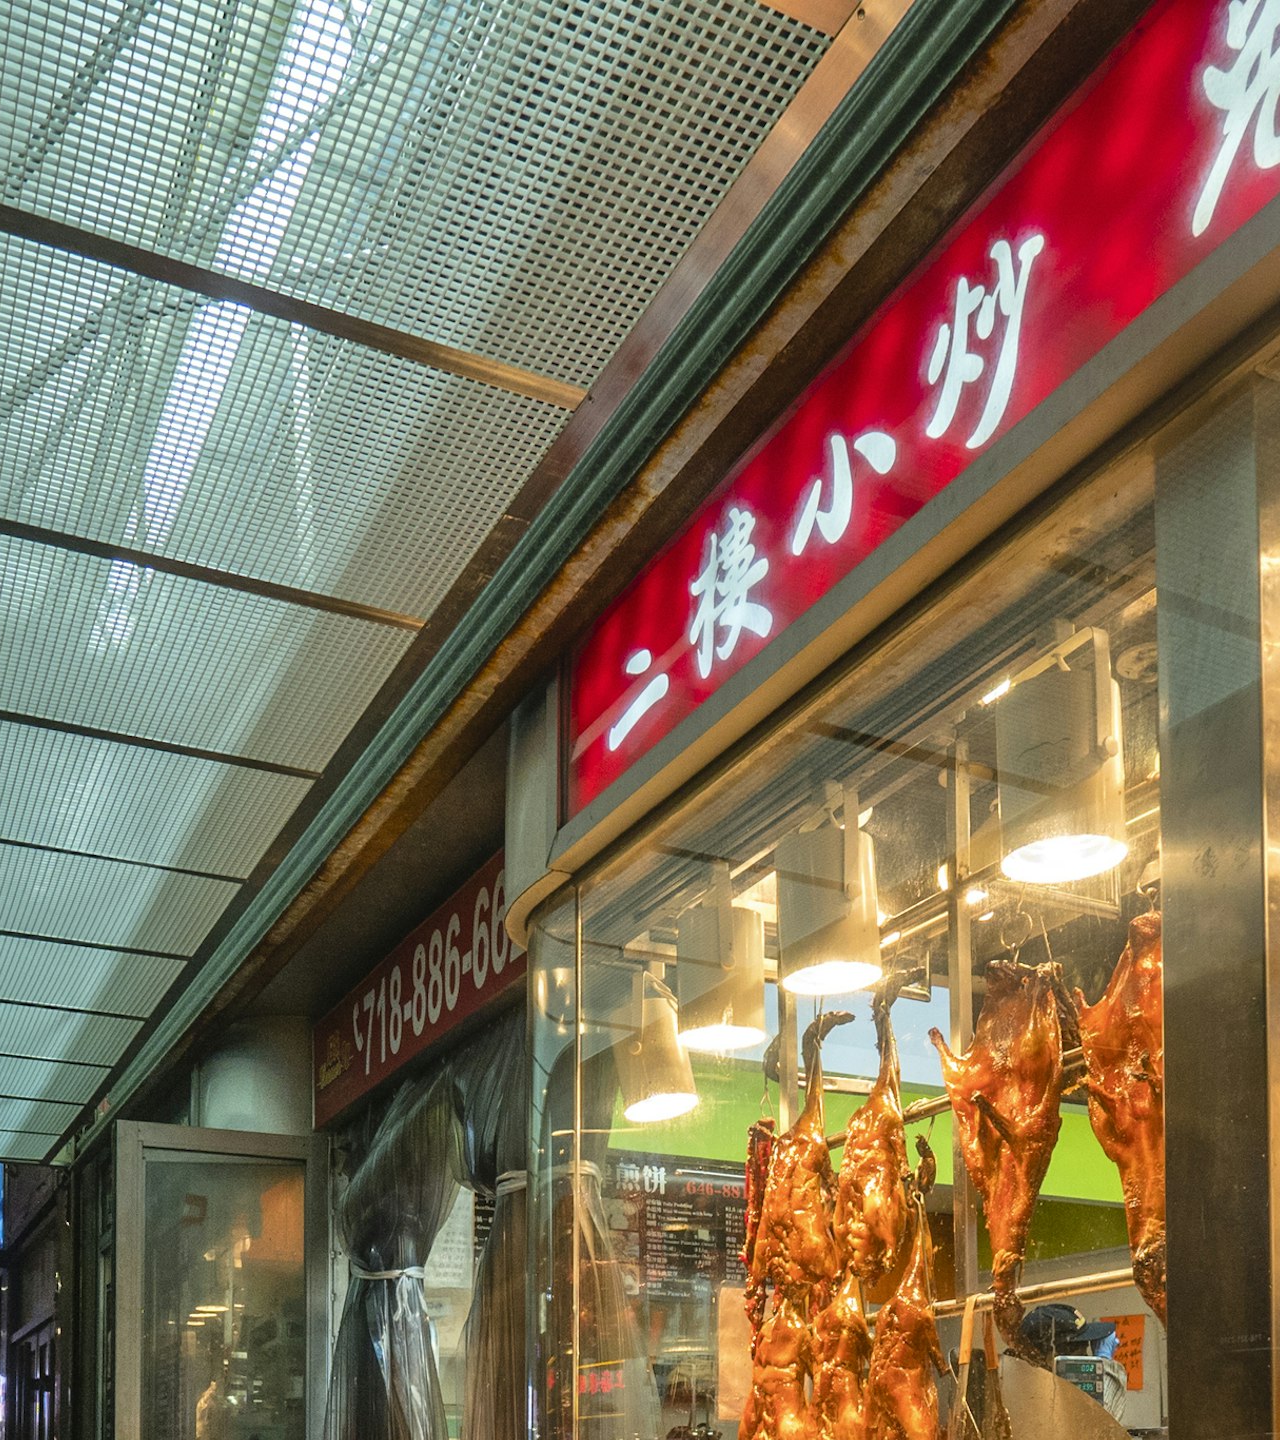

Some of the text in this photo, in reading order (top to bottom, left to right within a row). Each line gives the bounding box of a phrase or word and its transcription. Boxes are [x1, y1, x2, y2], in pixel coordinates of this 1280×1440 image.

[608, 233, 1046, 753] 二樓小炒
[363, 868, 527, 1076] 718-886-66
